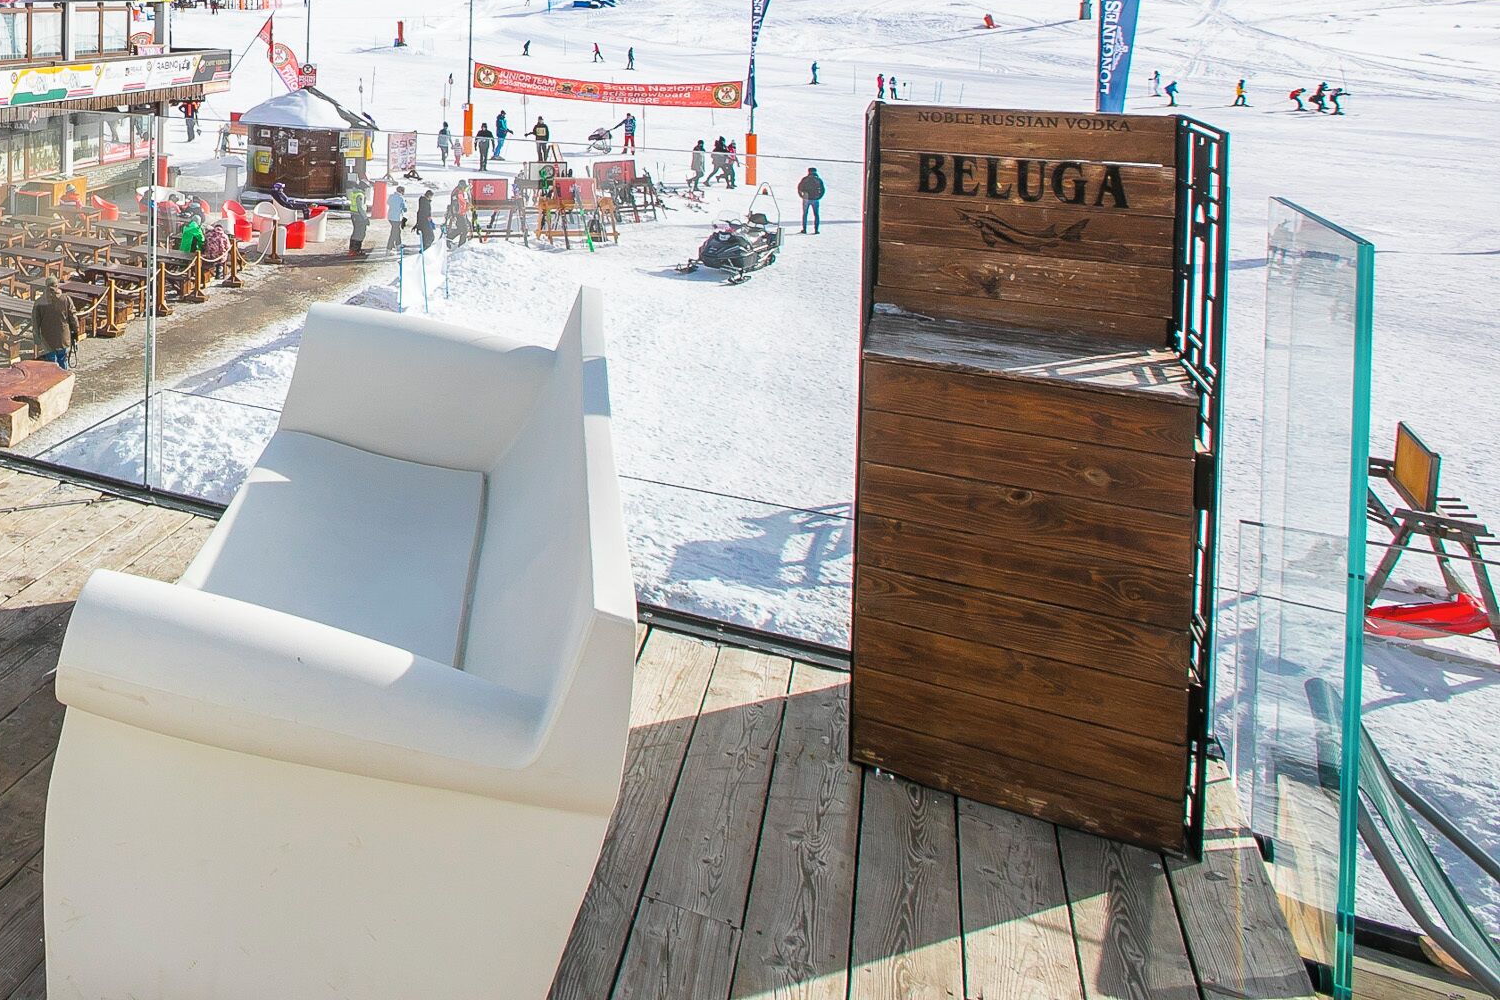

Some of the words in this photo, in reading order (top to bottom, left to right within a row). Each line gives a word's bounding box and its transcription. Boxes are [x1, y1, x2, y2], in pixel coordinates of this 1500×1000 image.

[1100, 0, 1123, 95] LONGINES
[498, 71, 532, 82] JUNIOR
[532, 76, 557, 87] TEAM
[603, 83, 646, 92] Scuola
[647, 84, 713, 92] Nazionale
[601, 96, 660, 104] SESTRIERE
[917, 111, 975, 125] NOBLE
[980, 115, 1059, 129] RUSSIAN
[1064, 117, 1132, 133] VODKA
[917, 153, 1130, 210] BELUGA
